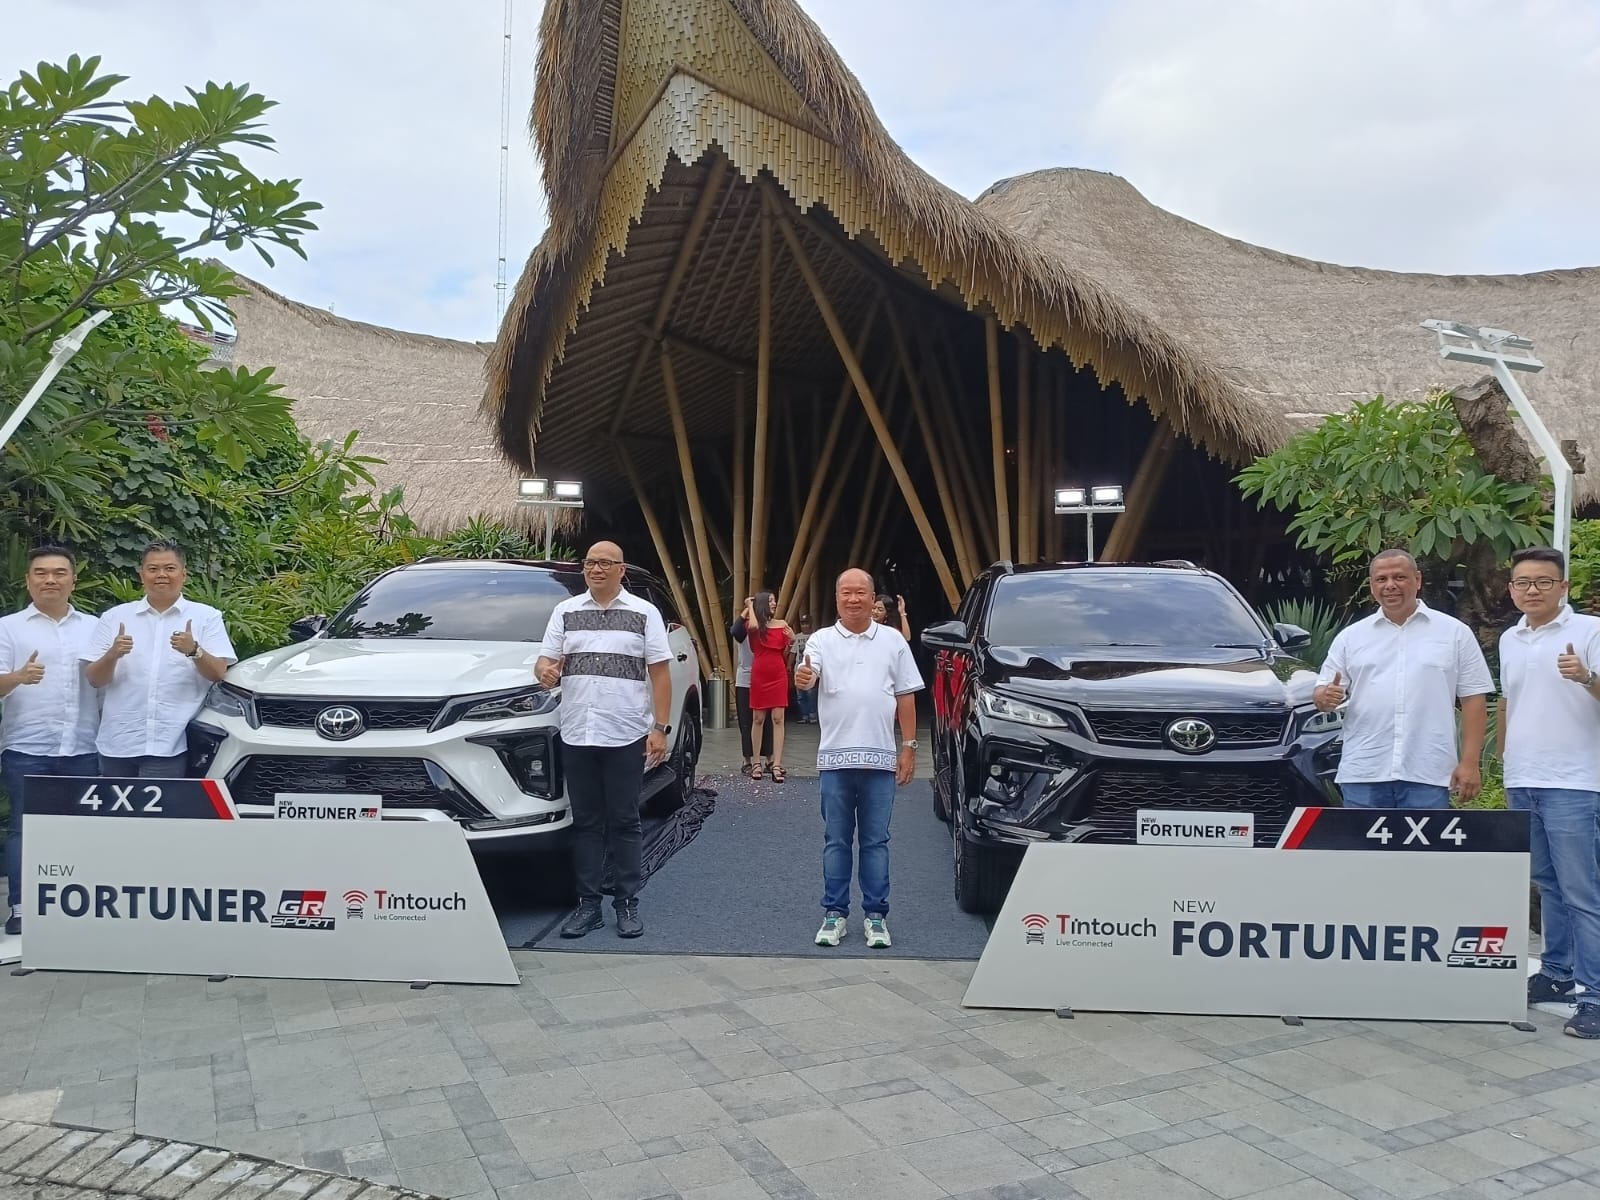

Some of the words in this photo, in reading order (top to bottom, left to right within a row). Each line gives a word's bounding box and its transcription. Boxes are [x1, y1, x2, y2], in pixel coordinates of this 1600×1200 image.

[278, 806, 357, 820] FORTUNER
[1140, 823, 1226, 838] FORTUNER
[38, 863, 75, 877] NEW
[37, 882, 269, 923] FORTUNER
[279, 897, 324, 915] GR
[1173, 900, 1216, 913] NEW
[271, 916, 335, 929] SPORT
[373, 913, 387, 921] Live
[388, 913, 427, 922] Connected
[1072, 939, 1113, 948] Connected
[1172, 920, 1442, 962] FORTUNER
[1453, 935, 1505, 953] GR
[1447, 954, 1514, 968] SPORT
